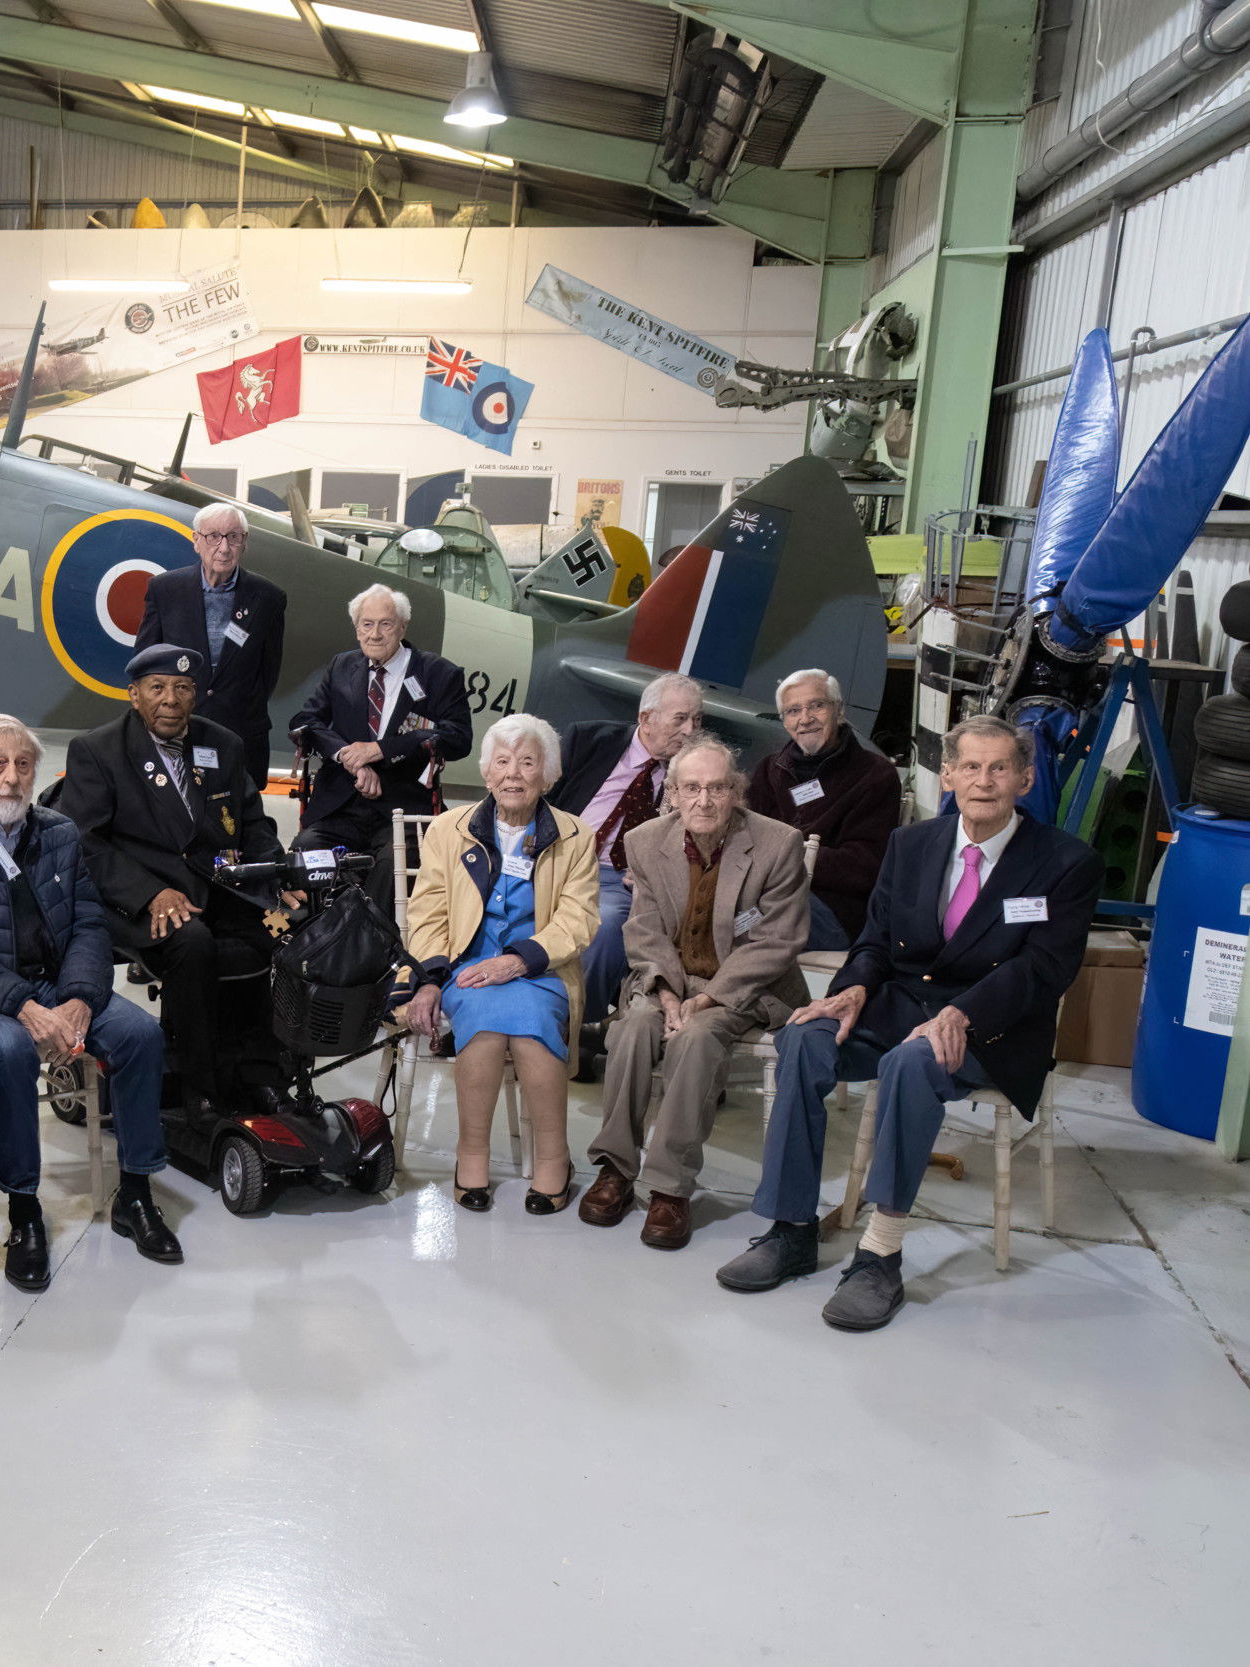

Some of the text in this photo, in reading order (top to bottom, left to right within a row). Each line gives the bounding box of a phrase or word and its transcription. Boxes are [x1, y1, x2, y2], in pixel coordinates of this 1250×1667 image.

[200, 267, 238, 288] SALUTE
[163, 298, 201, 323] THE
[204, 281, 240, 309] FEW
[597, 296, 730, 369] THE KENT SPITFIRE
[320, 344, 425, 354] WWW.KENTSPITFIRE.CO.UK
[578, 482, 621, 495] BRITONS
[308, 870, 335, 881] drive
